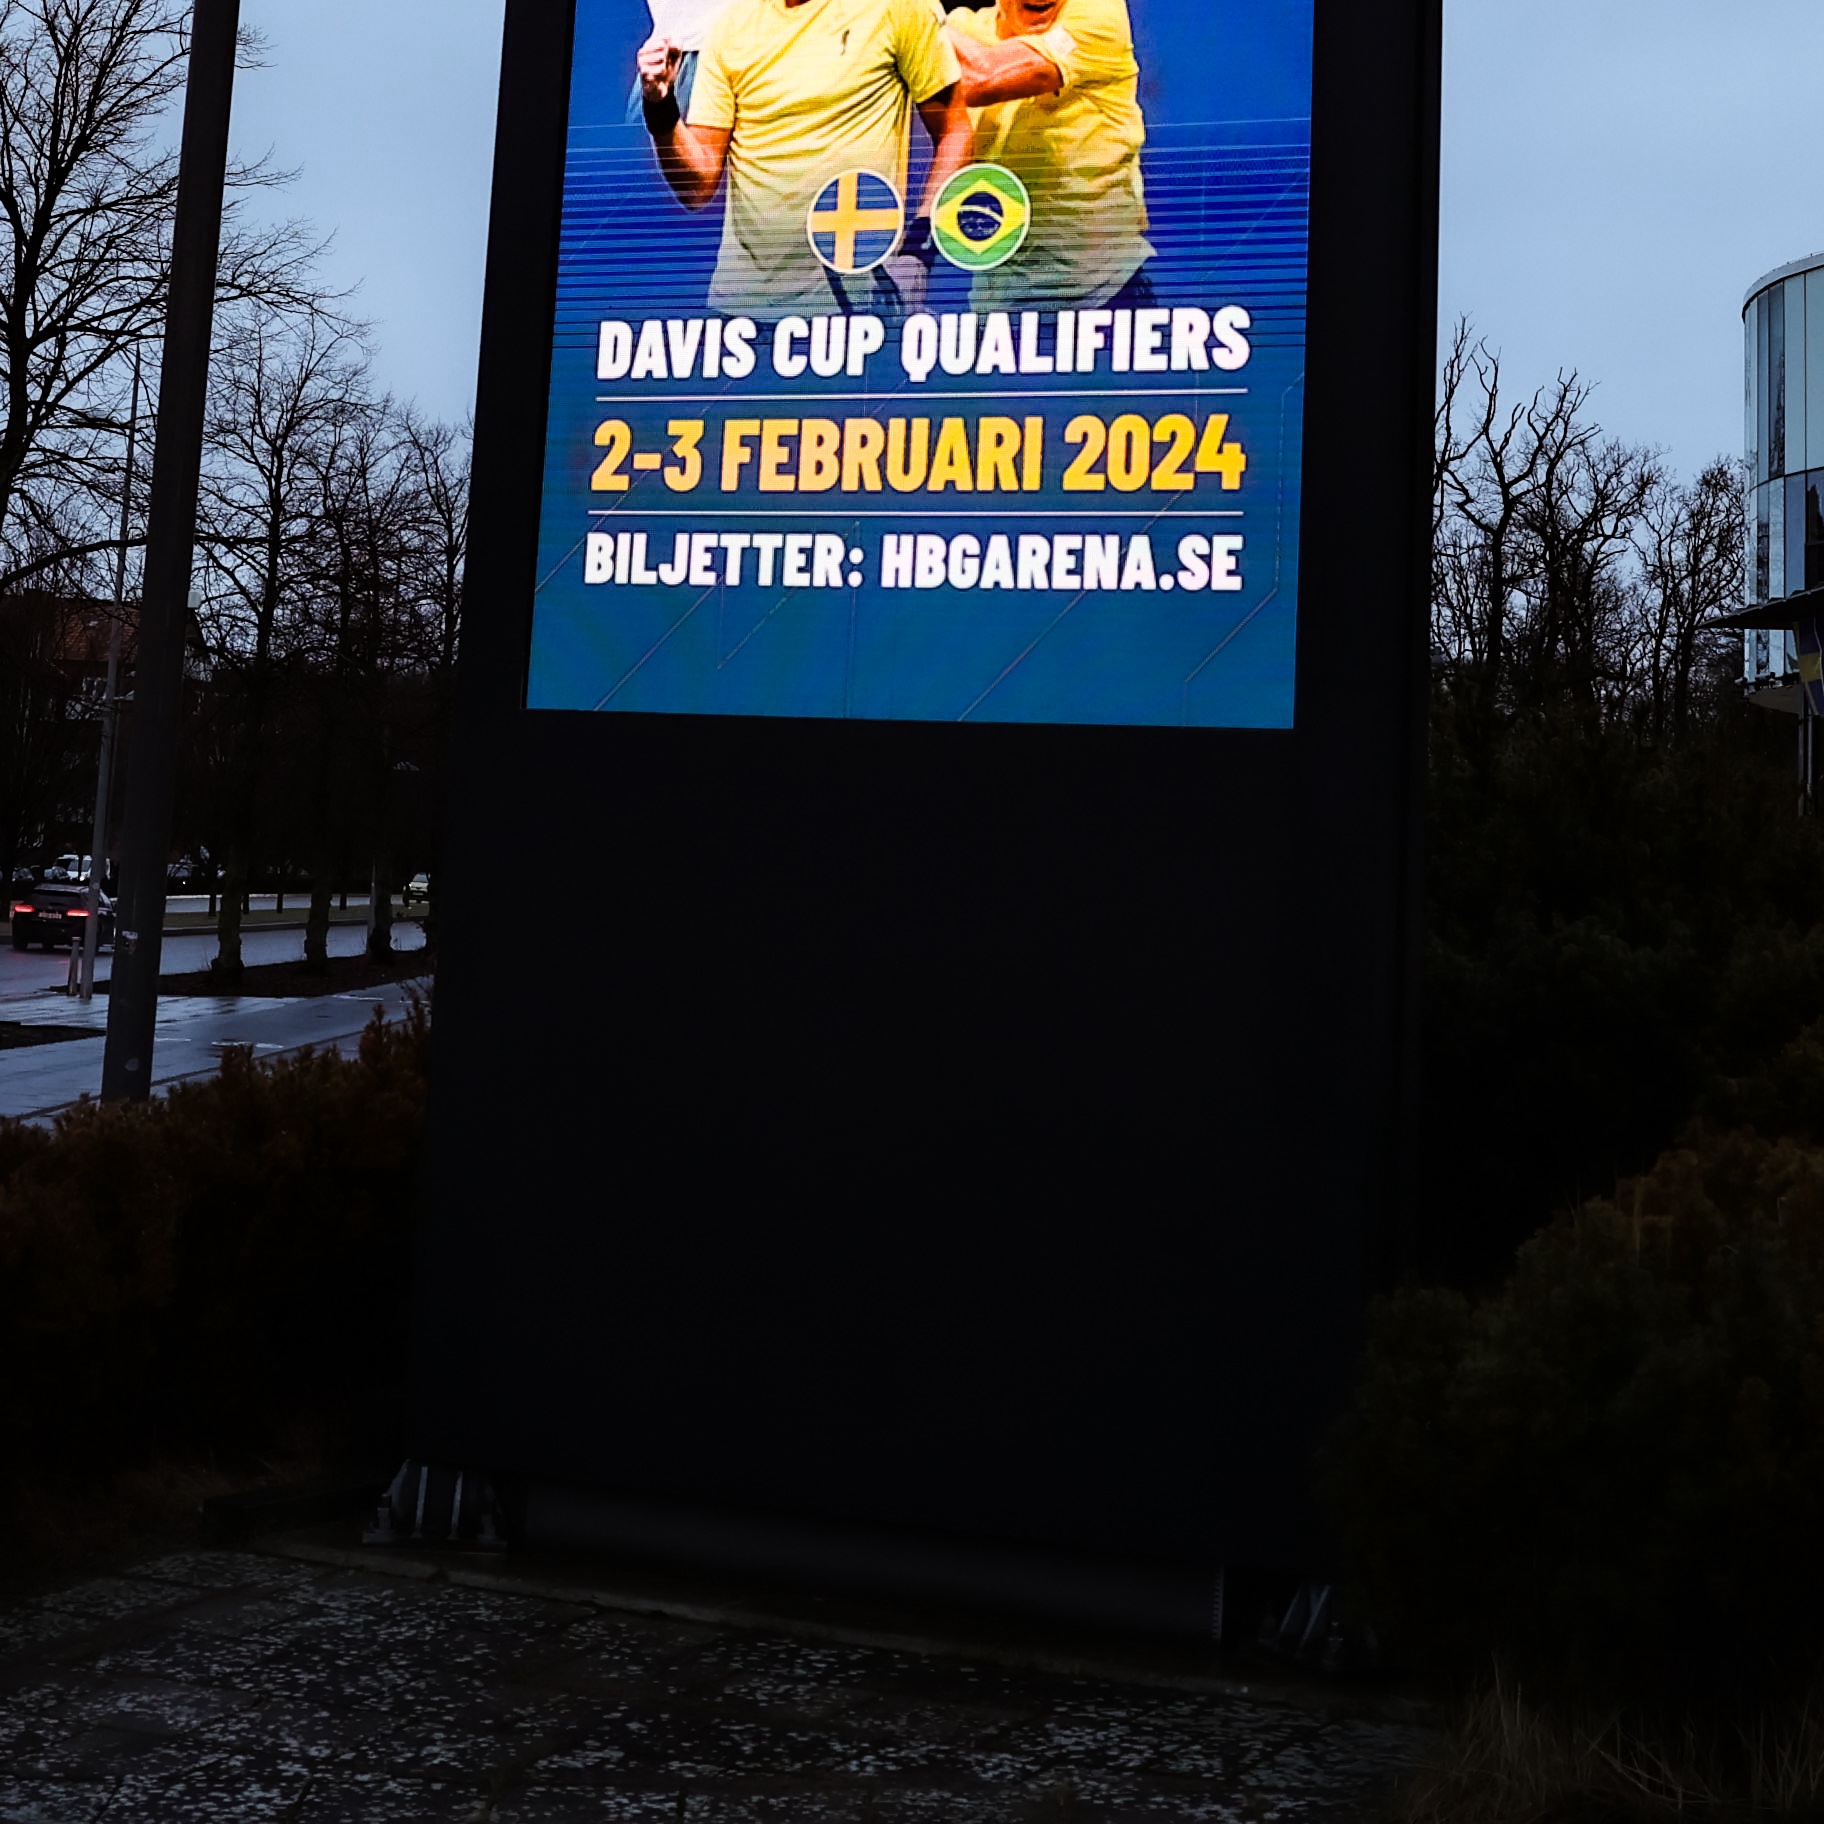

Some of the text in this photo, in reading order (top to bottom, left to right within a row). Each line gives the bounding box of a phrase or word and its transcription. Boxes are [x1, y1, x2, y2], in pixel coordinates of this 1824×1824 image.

[596, 305, 1251, 382] DAVIS CUP QUALIFIERS
[590, 413, 1247, 492] 2-3 FEBRUARI 2024
[584, 531, 1244, 591] BILJETTER: HBGARENA.SE
